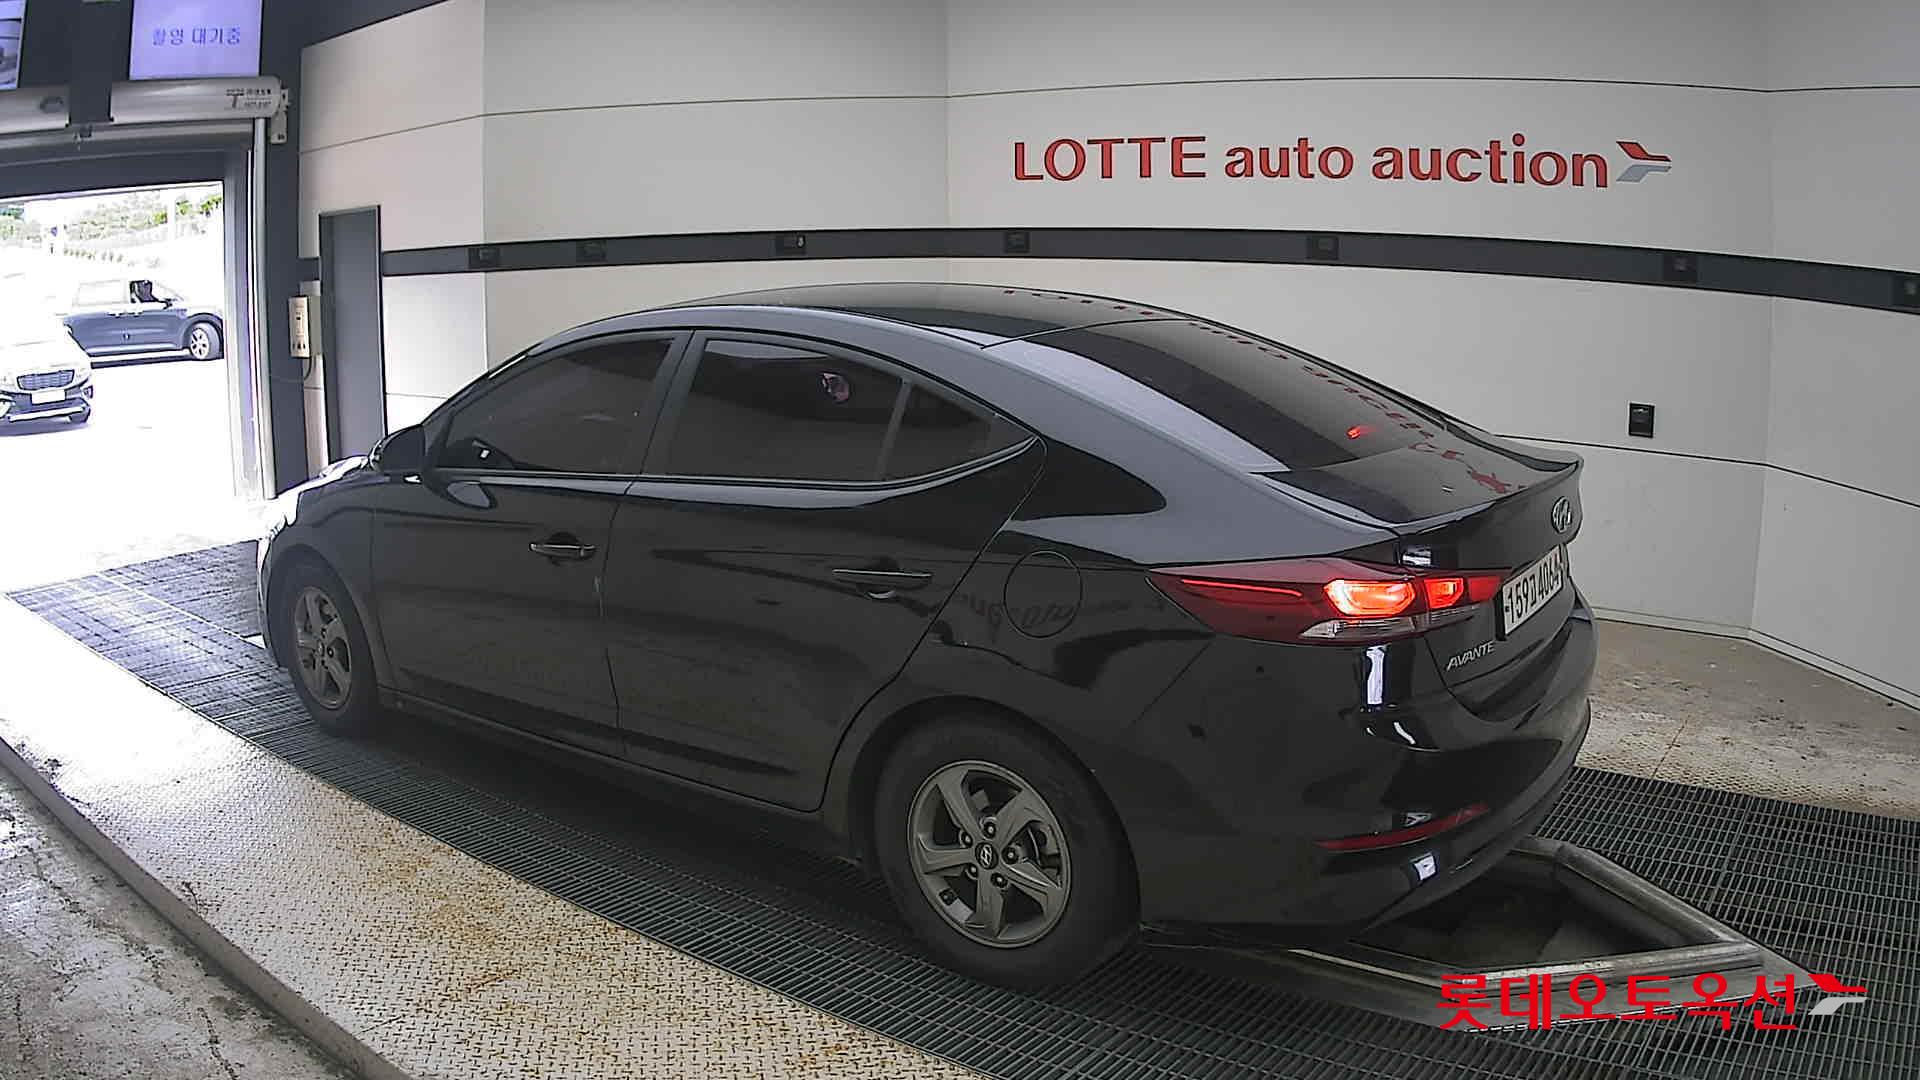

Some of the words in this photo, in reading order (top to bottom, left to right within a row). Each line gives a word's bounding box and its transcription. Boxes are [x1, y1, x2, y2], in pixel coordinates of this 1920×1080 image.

[1014, 136, 1206, 181] LOTTE
[1224, 137, 1355, 180] auto
[1371, 133, 1608, 188] auction
[1446, 640, 1496, 671] AVANTE
